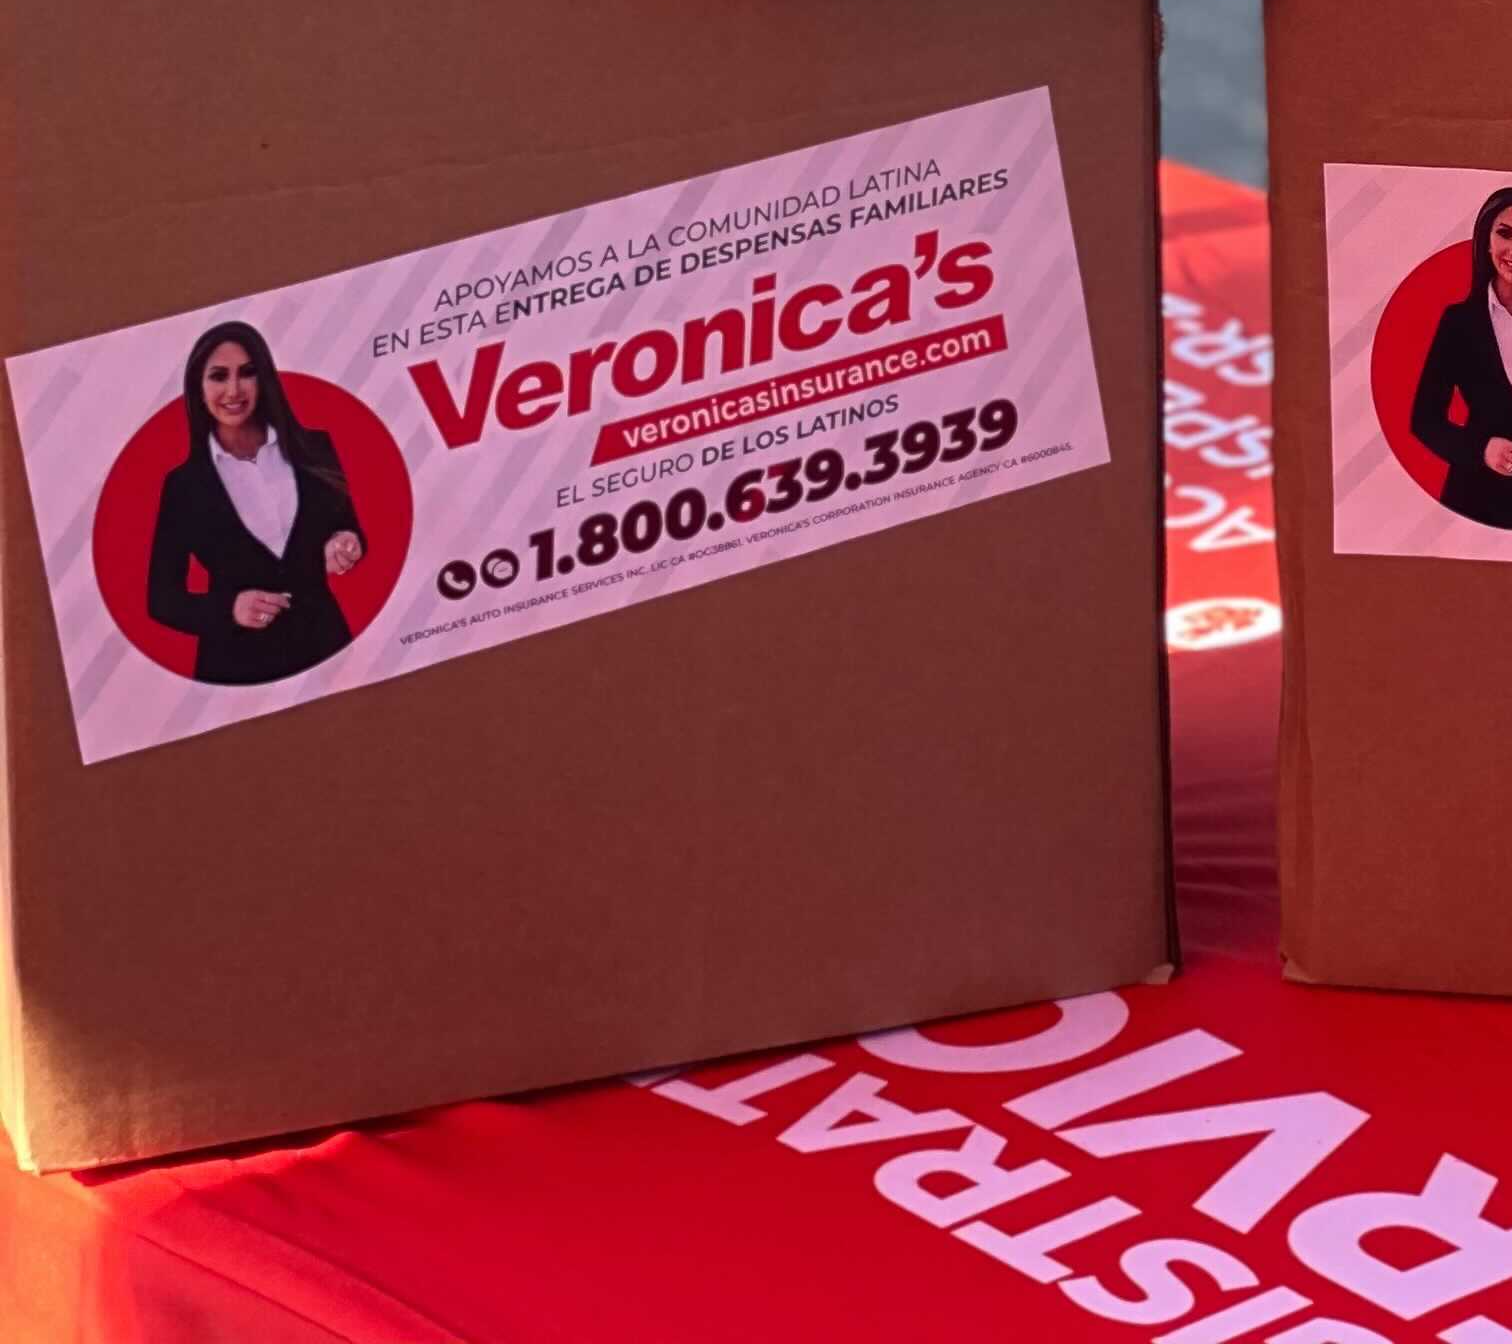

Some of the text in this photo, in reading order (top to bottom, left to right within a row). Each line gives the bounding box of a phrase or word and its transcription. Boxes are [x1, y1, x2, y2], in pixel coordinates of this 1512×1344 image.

[373, 168, 1009, 358] EN ESTA ENTREGA DE DESPENSAS FAMILIARES
[434, 158, 942, 313] APOYAMOS A LA COMUNIDAD LATINA
[408, 229, 995, 450] Veronica's
[622, 326, 992, 449] veronicasinsurance.com
[529, 398, 1019, 582] 1.800.639.3939
[555, 393, 900, 508] EL SEGURO DE LOS LATINOS
[400, 617, 468, 646] VERONICA'S
[469, 608, 502, 627] AUTO
[503, 587, 570, 616] INSURANCE
[571, 572, 625, 597] SERVICES
[747, 518, 811, 545] VERONICA'S
[812, 494, 891, 526] CORPORATION
[893, 475, 957, 502] INSURANCE
[958, 463, 1000, 483] AGENCY
[628, 1052, 1396, 1344] ISTRAT
